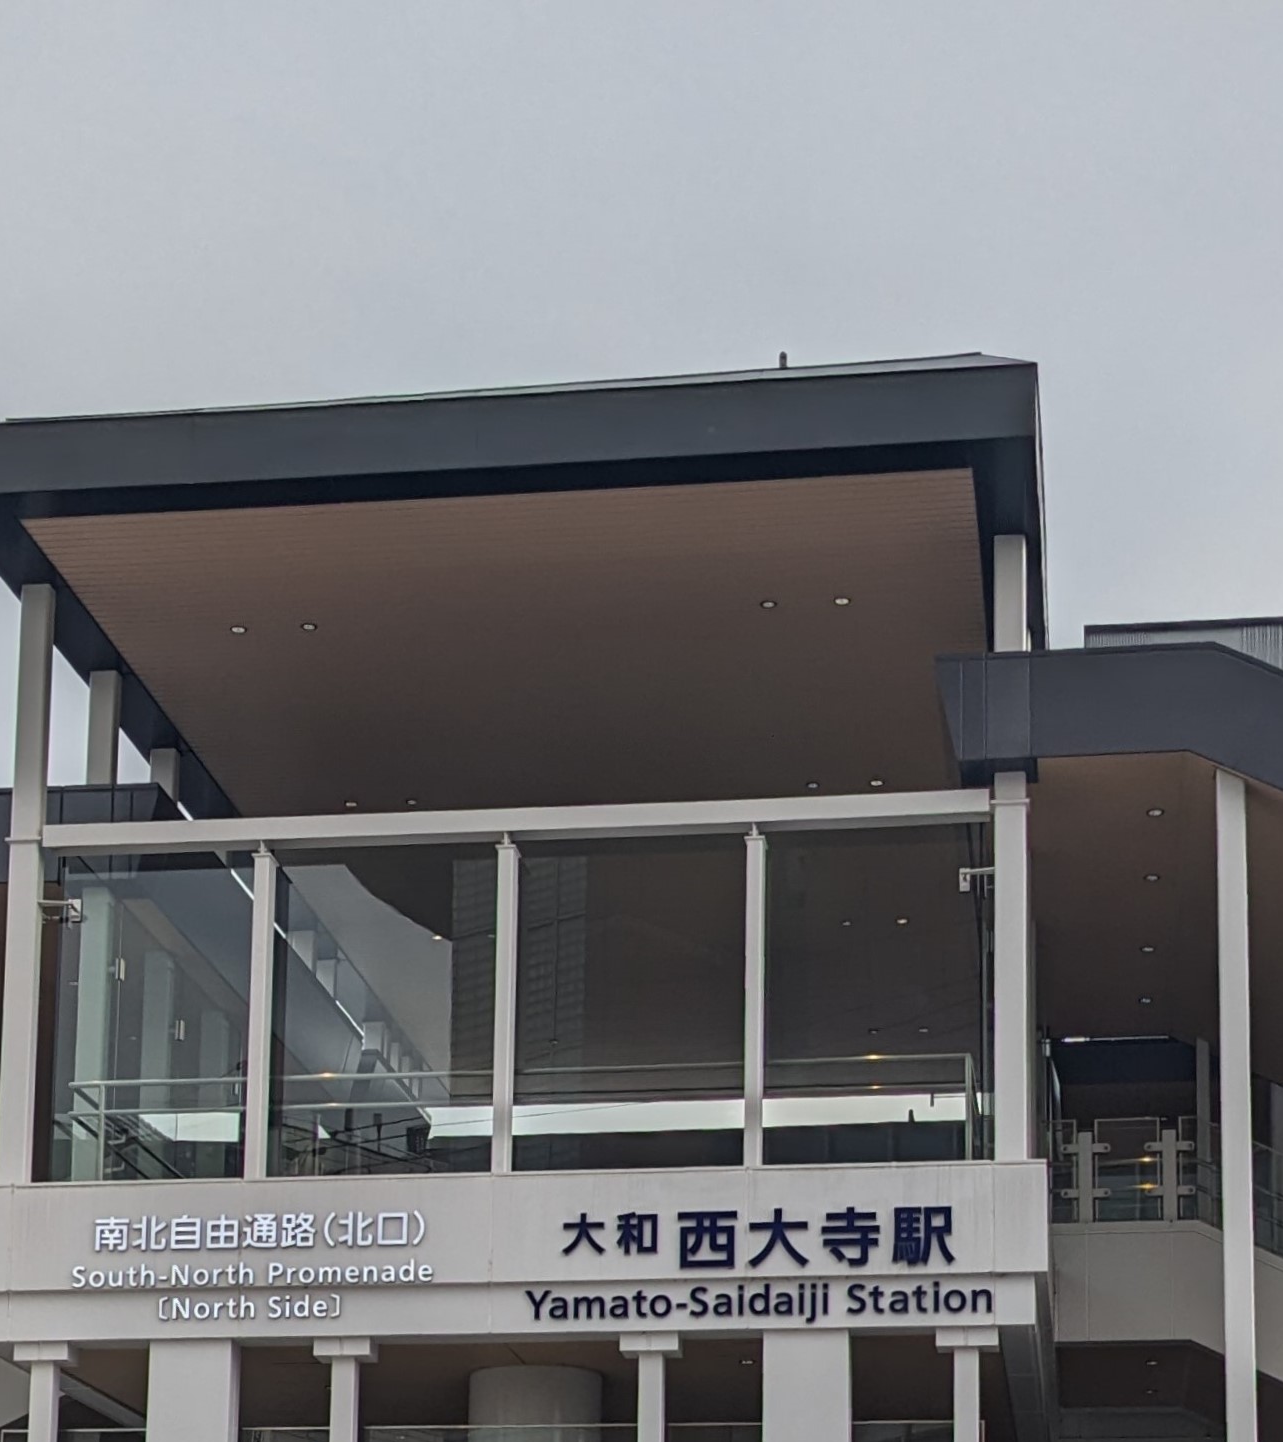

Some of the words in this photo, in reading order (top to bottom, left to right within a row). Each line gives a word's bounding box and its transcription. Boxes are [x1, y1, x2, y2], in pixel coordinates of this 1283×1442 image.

[72, 1262, 255, 1289] South-North
[268, 1259, 434, 1285] Promenade
[525, 1283, 830, 1324] Yamato-Saidaiji
[846, 1281, 994, 1316] Station
